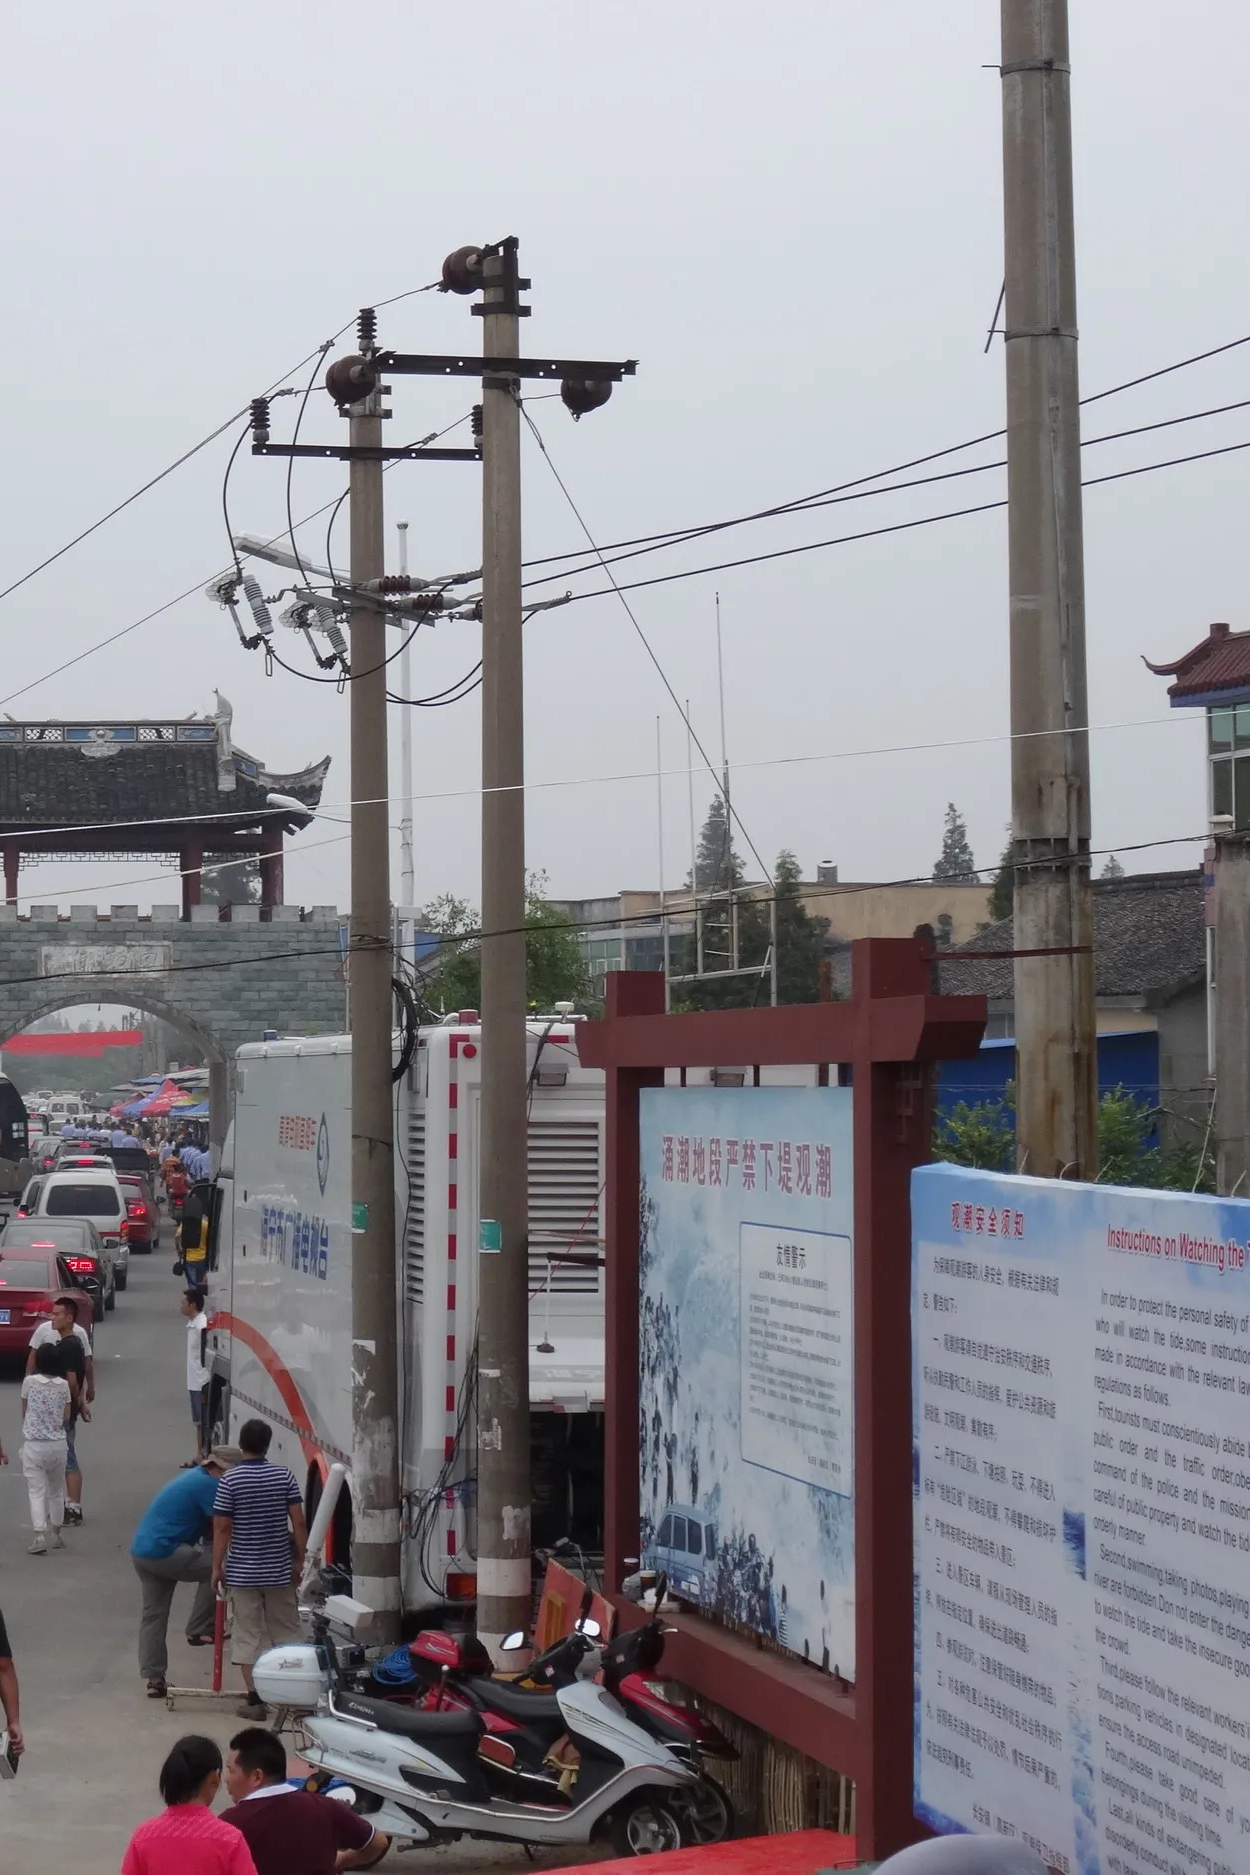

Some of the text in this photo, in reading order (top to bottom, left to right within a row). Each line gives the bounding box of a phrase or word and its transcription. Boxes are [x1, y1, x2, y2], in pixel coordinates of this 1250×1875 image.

[662, 1135, 831, 1198] 涌潮地段严禁下堤观潮
[951, 1202, 1025, 1238] 观潮安全须知
[1107, 1225, 1244, 1271] Instructions on Watching the
[1095, 1317, 1109, 1334] who
[1129, 1325, 1149, 1342] watch
[1154, 1329, 1165, 1346] the
[1110, 1291, 1127, 1308] order
[1130, 1297, 1136, 1311] to
[1138, 1298, 1163, 1315] protect
[1166, 1302, 1176, 1318] the
[1179, 1307, 1211, 1326] personal
[1214, 1311, 1238, 1335] safety
[1240, 1315, 1250, 1332] of
[1094, 1375, 1131, 1396] regulations
[1133, 1386, 1141, 1399] as
[1125, 1355, 1166, 1376] accordance
[1169, 1362, 1184, 1379] with
[1187, 1365, 1200, 1383] the
[1203, 1370, 1235, 1392] relevant
[1093, 1430, 1113, 1449] public
[1119, 1438, 1138, 1457] order
[1144, 1445, 1157, 1462] and
[1164, 1449, 1176, 1468] the
[1183, 1454, 1205, 1476] traffic
[1142, 1415, 1160, 1433] must
[1162, 1422, 1220, 1454] conscientiously
[1223, 1436, 1245, 1457] abide
[1093, 1460, 1126, 1482] command
[1130, 1468, 1138, 1485] of
[1141, 1472, 1153, 1490] the
[1157, 1479, 1179, 1499] police
[1183, 1488, 1198, 1504] and
[1202, 1492, 1215, 1510] the
[1093, 1488, 1116, 1507] careful
[1118, 1493, 1125, 1510] of
[1126, 1496, 1148, 1518] public
[1149, 1507, 1179, 1533] property
[1181, 1517, 1196, 1533] and
[1198, 1522, 1221, 1542] watch
[1223, 1528, 1236, 1548] the
[1110, 1579, 1122, 1595] are
[1175, 1602, 1188, 1621] not
[1189, 1609, 1209, 1628] enter
[1211, 1616, 1223, 1636] the
[1103, 1603, 1123, 1623] watch
[1124, 1610, 1135, 1629] the
[1137, 1616, 1150, 1634] tide
[1152, 1625, 1165, 1642] and
[1167, 1629, 1183, 1649] take
[1185, 1634, 1197, 1655] the
[1199, 1640, 1232, 1670] insecure
[1167, 1686, 1180, 1707] the
[1181, 1696, 1211, 1721] relevant
[1137, 1733, 1162, 1757] access
[1163, 1747, 1180, 1765] road
[1185, 1725, 1227, 1760] designated
[1158, 1770, 1174, 1792] take
[1179, 1783, 1198, 1804] good
[1203, 1797, 1220, 1817] care
[1226, 1806, 1234, 1823] of
